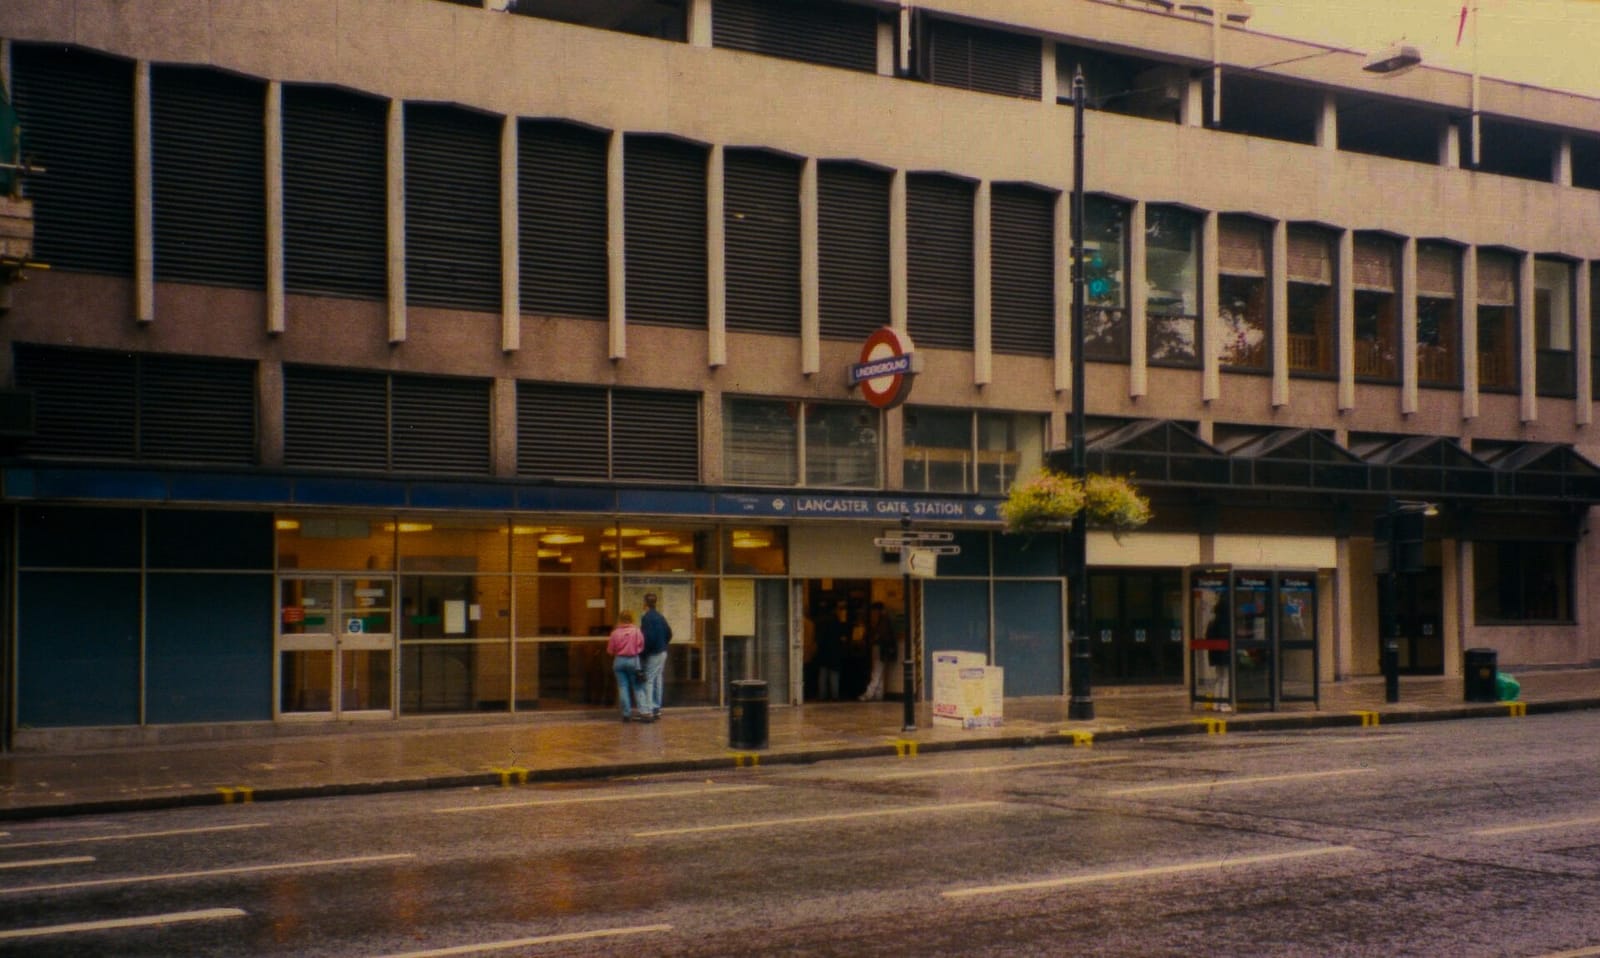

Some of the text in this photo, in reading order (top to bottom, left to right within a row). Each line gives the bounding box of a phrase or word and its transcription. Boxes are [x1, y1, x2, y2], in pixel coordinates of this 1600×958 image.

[856, 359, 907, 377] UNDERGROUND
[797, 499, 963, 514] LANCASTER GATE STATION
